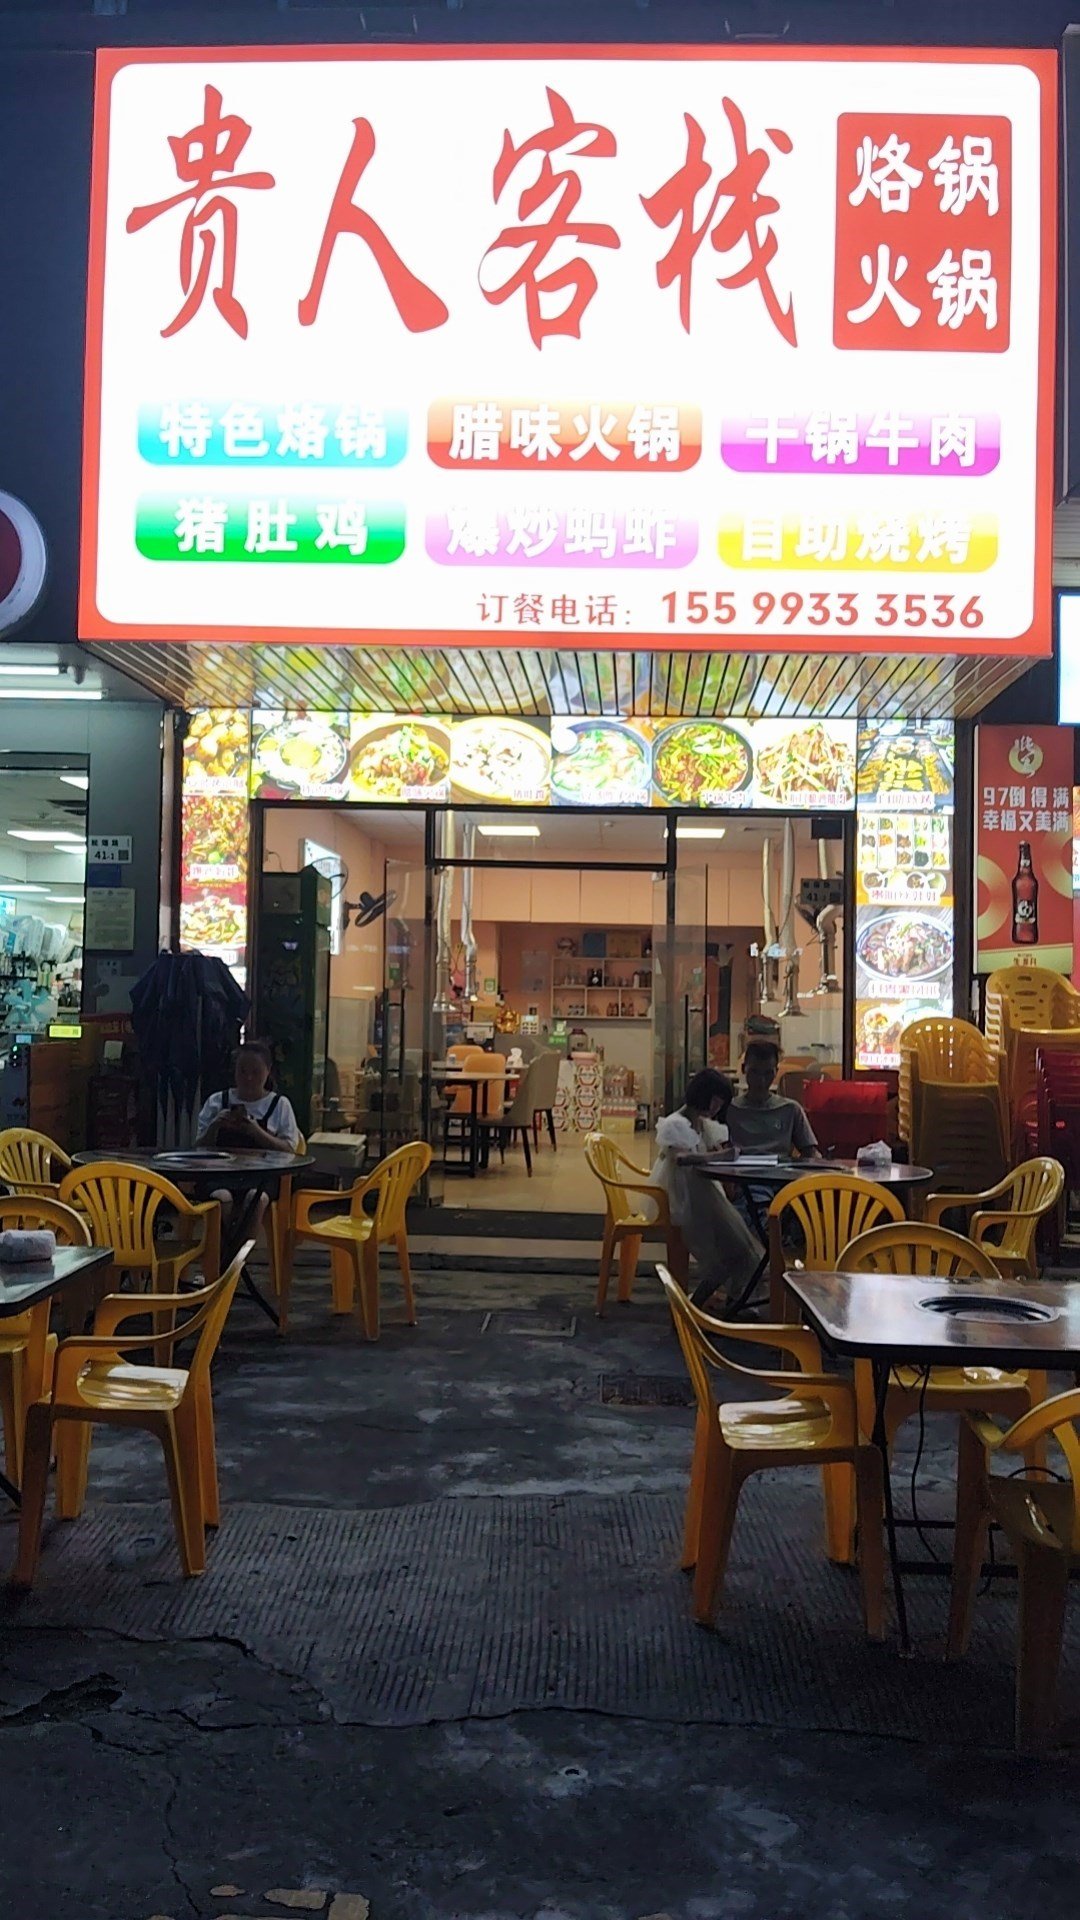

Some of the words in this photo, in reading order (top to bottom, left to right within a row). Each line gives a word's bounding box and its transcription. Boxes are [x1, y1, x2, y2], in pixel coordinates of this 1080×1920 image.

[848, 133, 1000, 217] 烙锅
[126, 83, 799, 352] 贵人客栈
[845, 243, 998, 330] 火锅
[158, 402, 388, 460] 特色烙锅
[448, 401, 681, 462] 腊味火锅
[745, 408, 976, 467] 干锅牛肉
[174, 498, 369, 555] 猪肚鸡
[446, 504, 677, 560] 爆炒蚂蚱
[741, 508, 972, 565] 自助烧烤
[661, 591, 737, 624] 155
[752, 592, 859, 626] 9933
[875, 593, 984, 628] 3536
